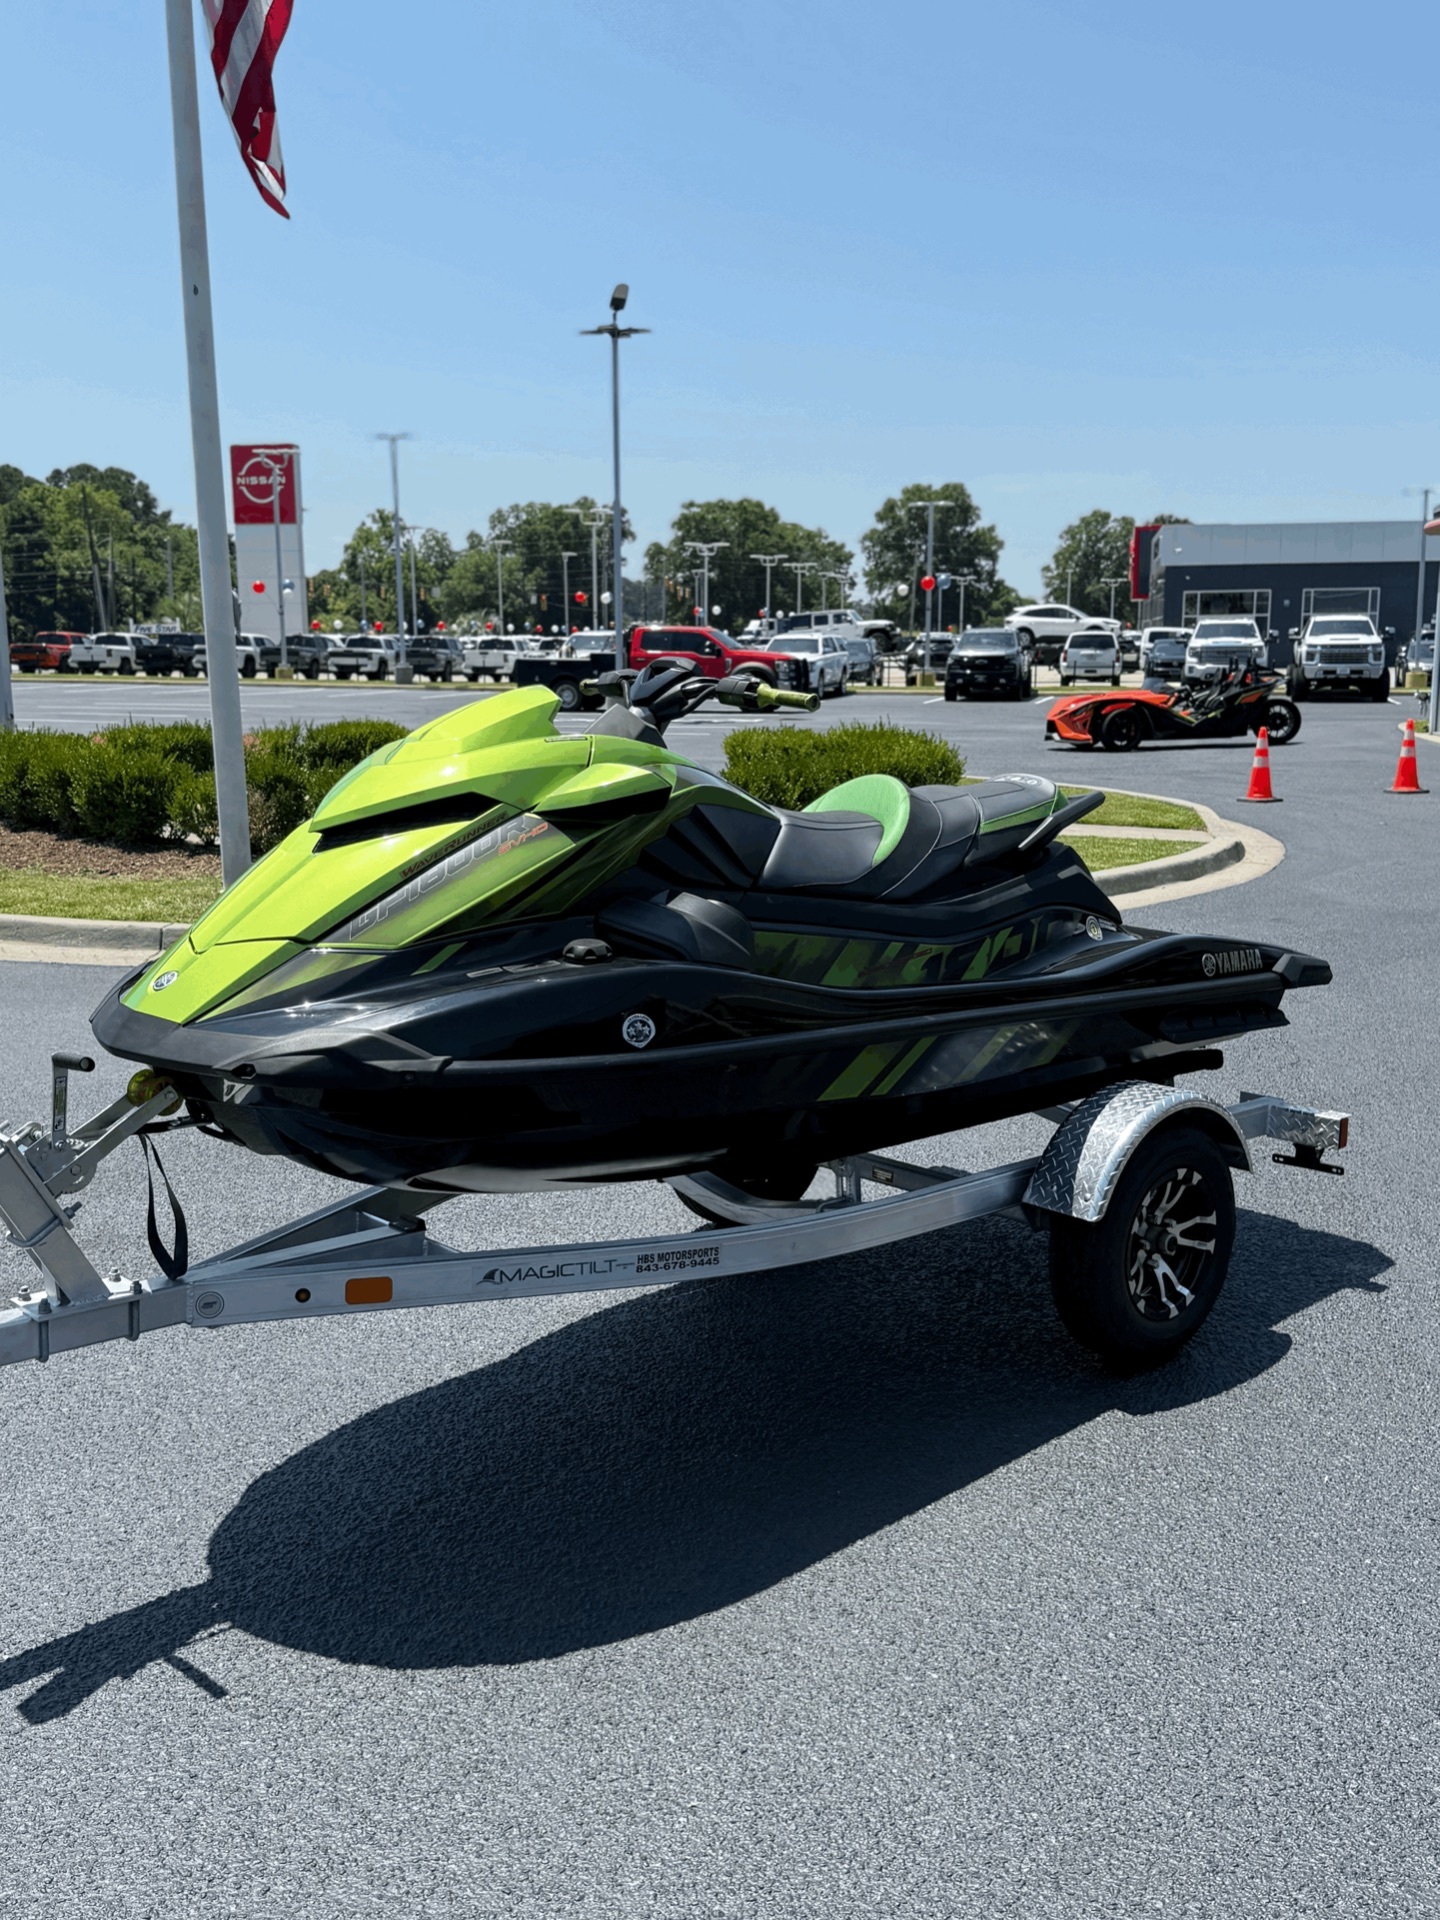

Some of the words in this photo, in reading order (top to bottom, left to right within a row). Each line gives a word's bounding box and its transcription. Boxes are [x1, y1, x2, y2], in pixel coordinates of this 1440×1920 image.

[156, 624, 178, 633] STAR
[498, 821, 549, 856] SVHO
[1214, 948, 1263, 974] YAMAHA
[635, 1256, 720, 1274] 843-678-9445
[636, 1252, 656, 1265] HBS
[657, 1246, 720, 1262] MOTORSPORTS
[499, 1258, 618, 1284] MAGICTILT
